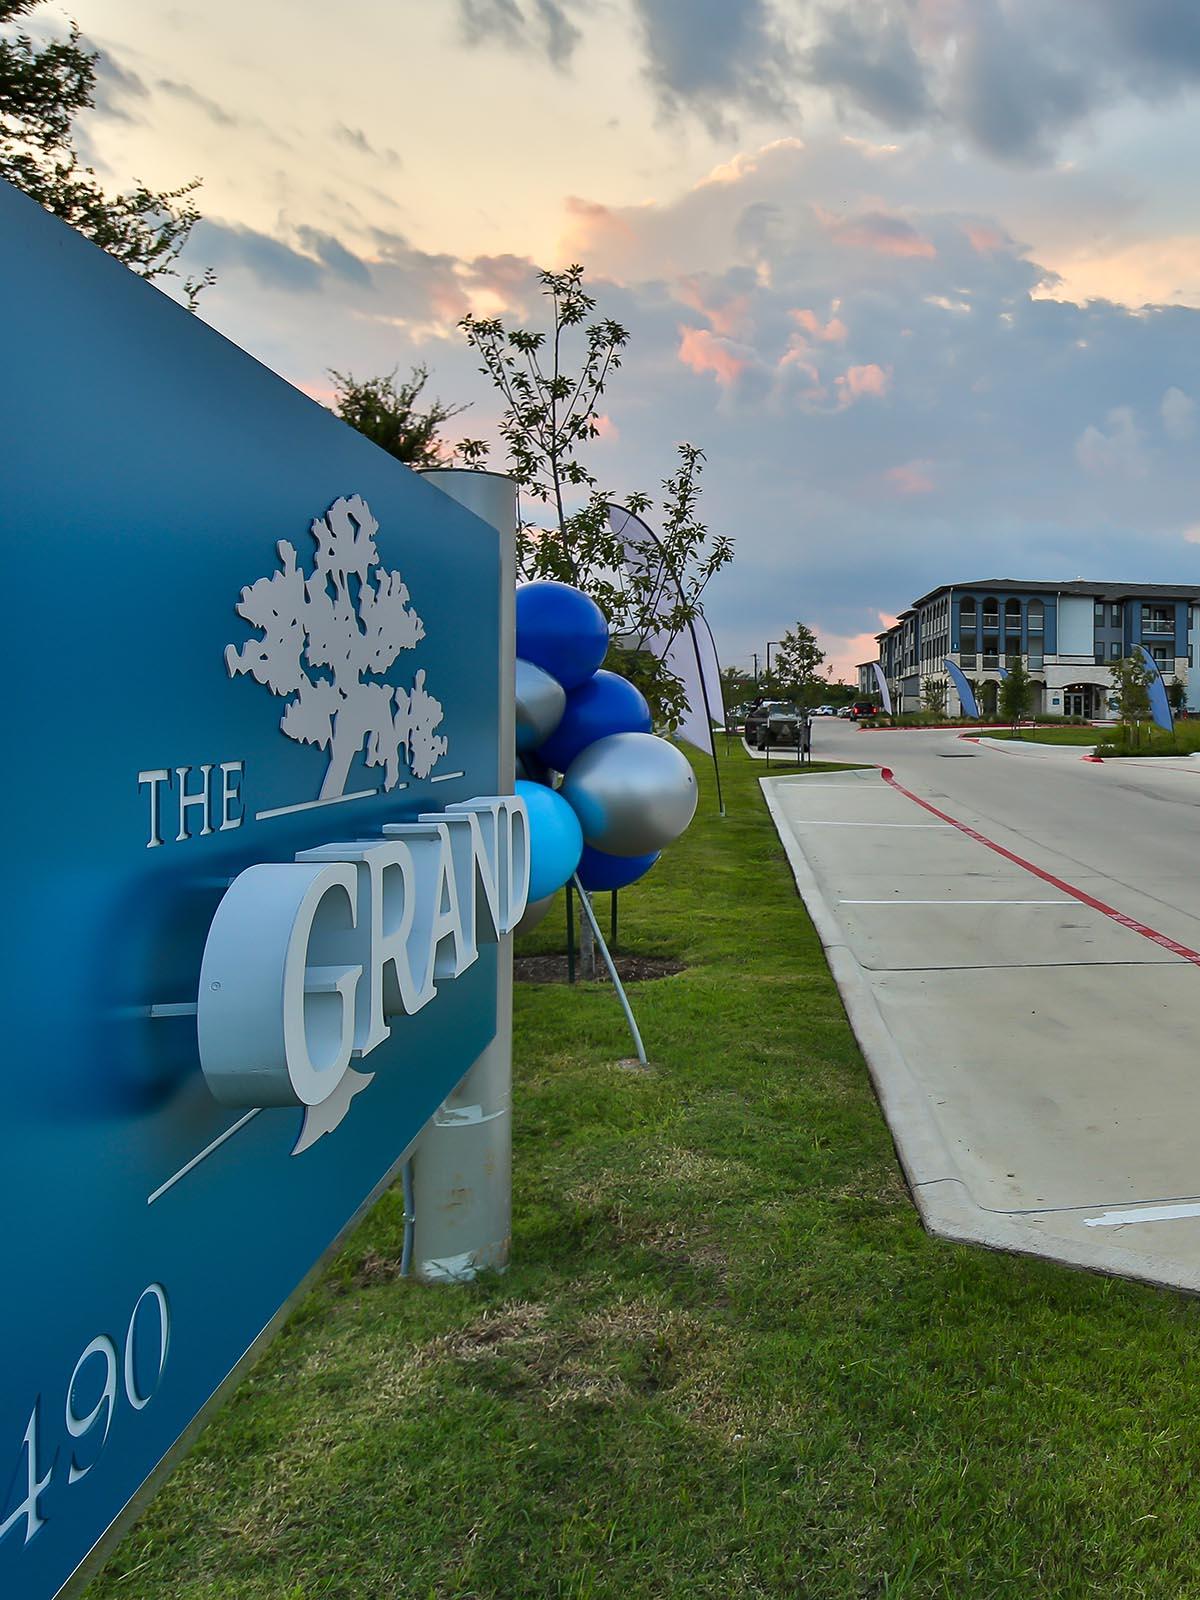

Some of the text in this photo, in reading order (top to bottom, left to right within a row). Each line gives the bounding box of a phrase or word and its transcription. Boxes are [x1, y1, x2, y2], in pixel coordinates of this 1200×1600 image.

[138, 761, 245, 848] THE
[197, 795, 531, 1106] GRAND
[0, 1281, 171, 1545] 490
